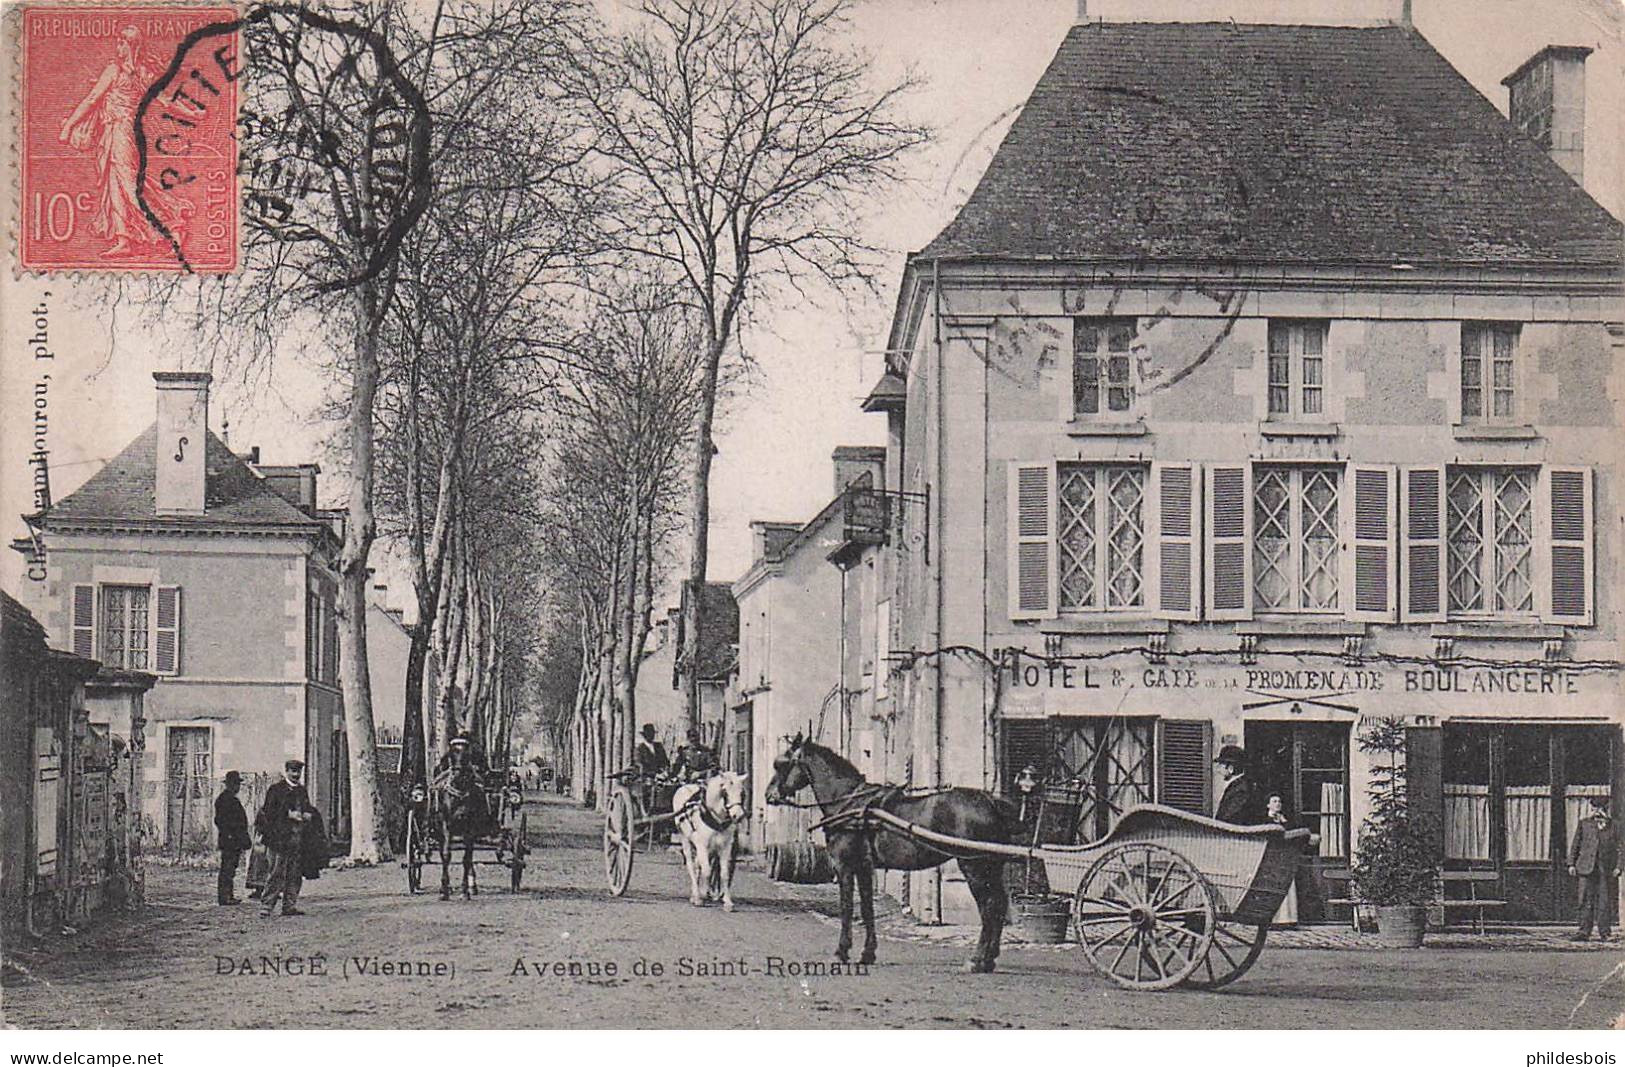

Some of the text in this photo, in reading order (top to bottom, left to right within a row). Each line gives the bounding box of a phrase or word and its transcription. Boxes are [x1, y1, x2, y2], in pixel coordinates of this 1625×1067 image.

[207, 170, 226, 253] POSTES
[1245, 670, 1384, 690] PROMENADE
[1405, 669, 1580, 694] BOULANGERIE
